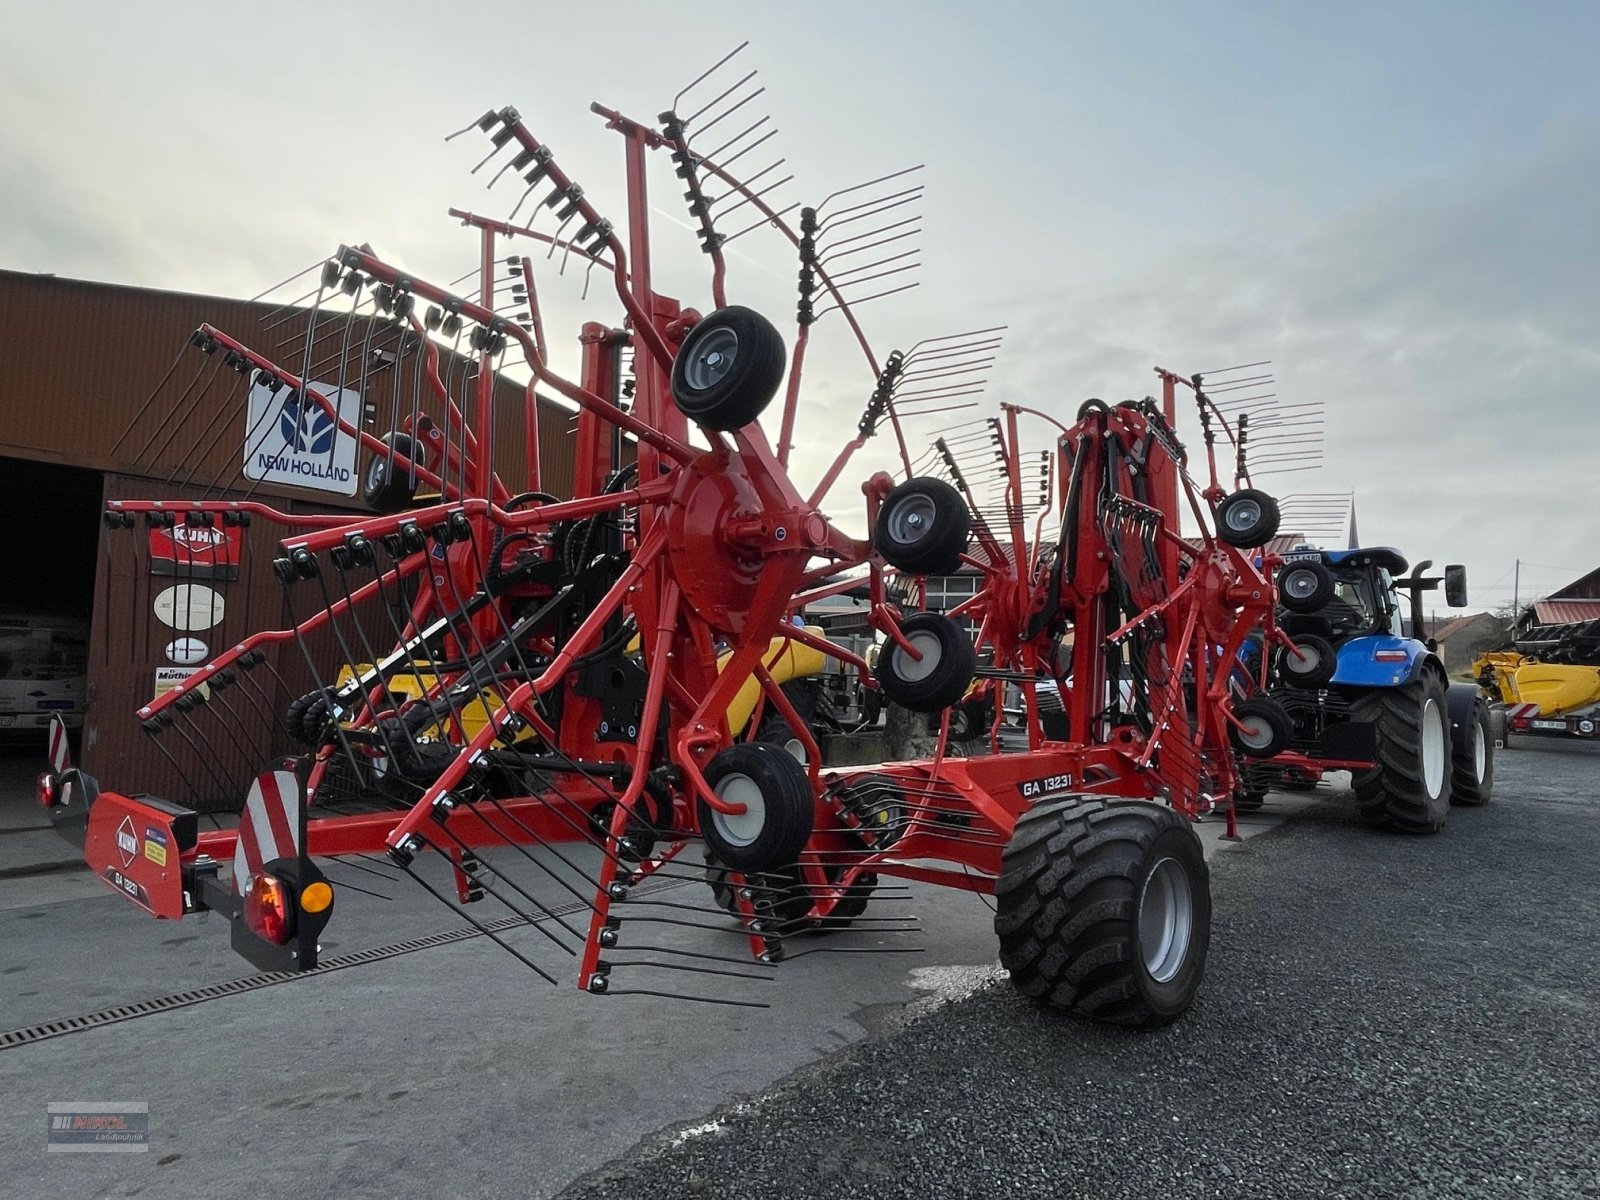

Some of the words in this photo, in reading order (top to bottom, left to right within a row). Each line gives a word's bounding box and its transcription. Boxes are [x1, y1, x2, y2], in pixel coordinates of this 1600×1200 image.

[258, 453, 290, 472] NEW
[291, 459, 350, 482] HOLLAND
[1023, 781, 1040, 796] GA
[1044, 773, 1072, 791] 13231
